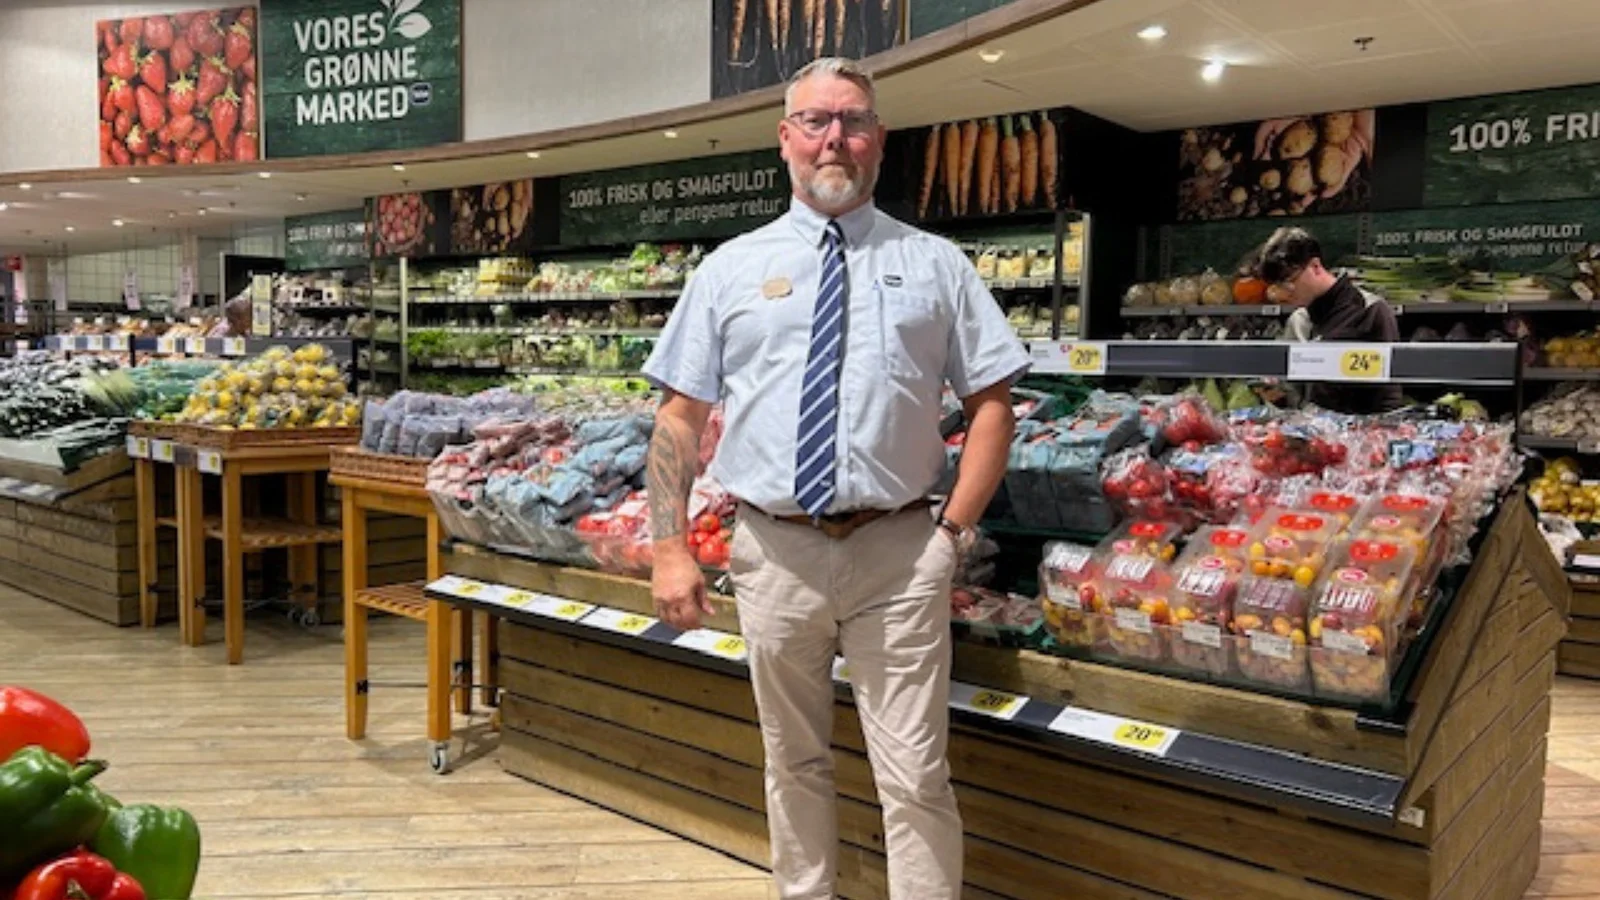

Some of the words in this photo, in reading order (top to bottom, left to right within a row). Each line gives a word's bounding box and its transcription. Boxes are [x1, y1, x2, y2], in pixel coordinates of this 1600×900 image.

[294, 11, 386, 52] VORES
[304, 46, 418, 89] GRØNNE
[296, 85, 409, 126] MARKED
[1449, 117, 1532, 152] 100%
[569, 187, 603, 209] 100%
[607, 182, 648, 204] FRISK
[652, 180, 673, 200] OG
[677, 167, 778, 198] SMAGFULDT
[640, 204, 671, 225] eller
[674, 202, 740, 226] pengene
[741, 197, 783, 216] retur
[1375, 231, 1410, 246] 100%
[1414, 228, 1458, 244] FRISK
[1461, 226, 1483, 242] OG
[1487, 222, 1583, 241] SMAGFULDT
[1349, 351, 1370, 372] 24
[1123, 724, 1151, 741] 20
